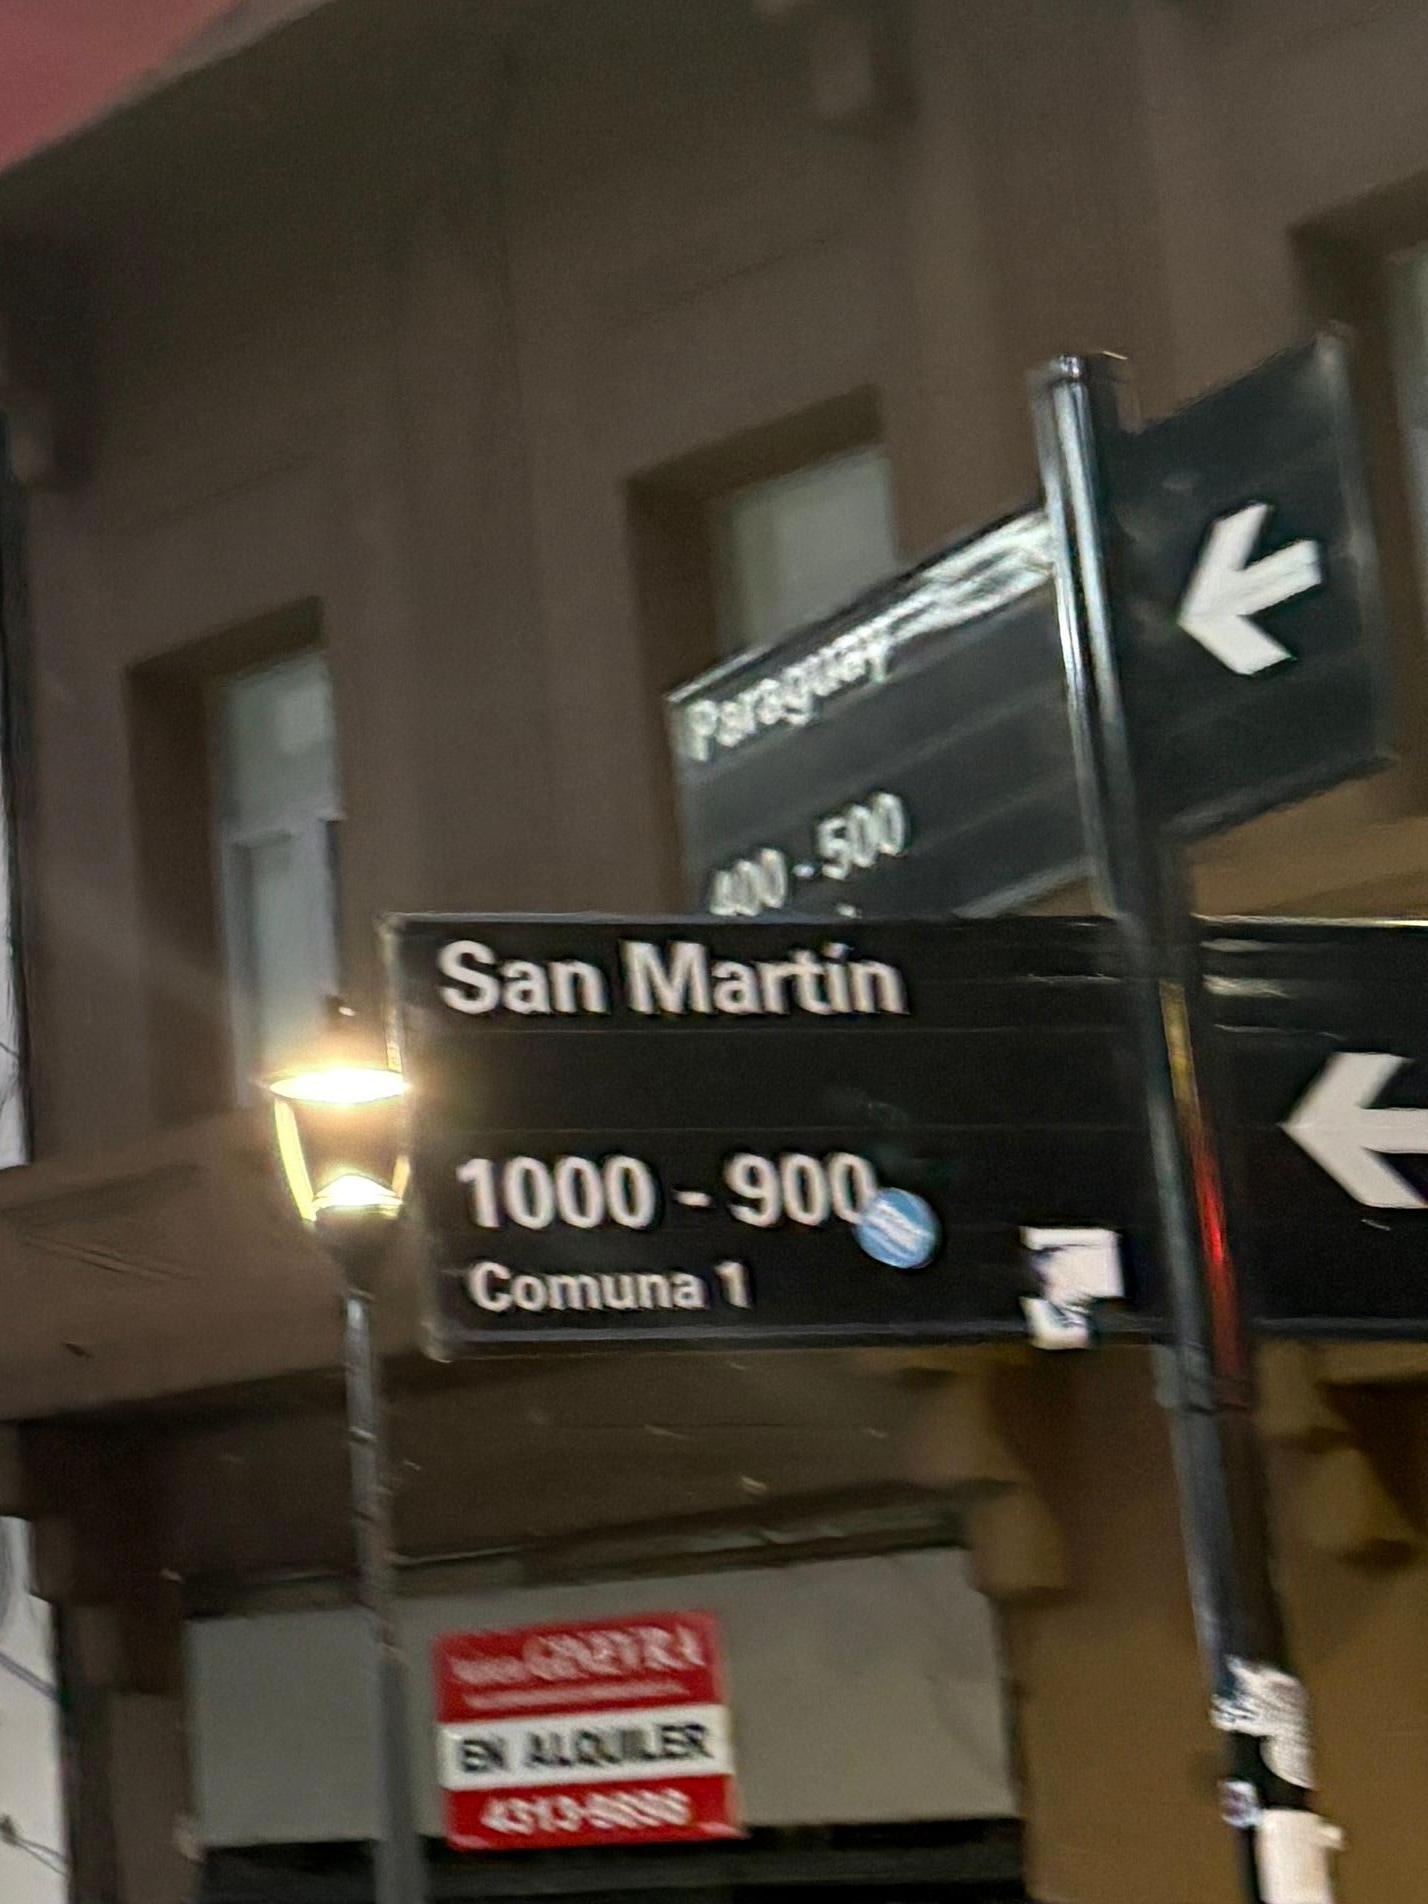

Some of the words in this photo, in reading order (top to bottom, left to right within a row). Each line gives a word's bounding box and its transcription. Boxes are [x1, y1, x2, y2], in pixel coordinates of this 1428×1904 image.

[687, 621, 893, 762] Paraguay
[709, 847, 787, 917] 400
[817, 792, 907, 880] 500
[437, 938, 608, 1016] San
[617, 938, 912, 1017] Martín
[457, 1153, 660, 1231] 1000
[673, 1188, 716, 1209] -
[721, 1150, 880, 1229] 900
[467, 1259, 706, 1313] Comuna
[713, 1258, 755, 1310] 1
[457, 1731, 512, 1775] EN
[524, 1721, 714, 1771] ALQUILER
